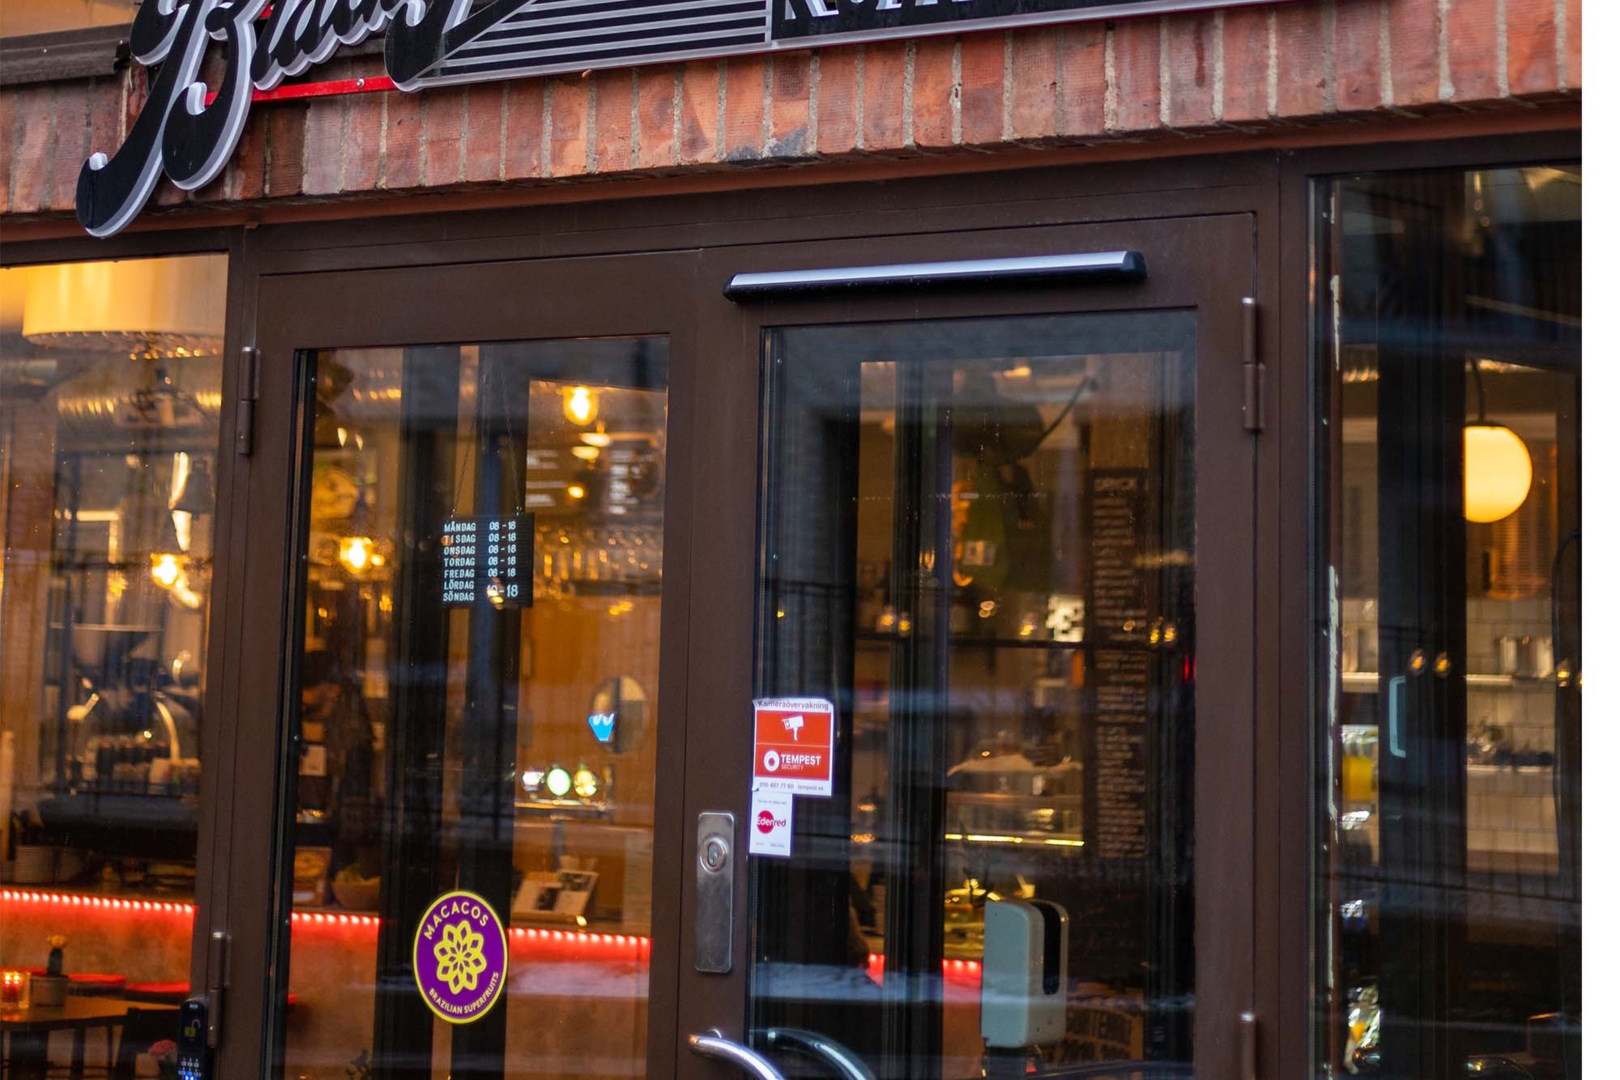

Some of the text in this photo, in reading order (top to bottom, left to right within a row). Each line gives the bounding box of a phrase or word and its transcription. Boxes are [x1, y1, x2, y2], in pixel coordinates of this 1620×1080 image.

[443, 521, 476, 532] MÅNDAG
[444, 534, 476, 544] TISDAG
[443, 546, 476, 555] ONSDAG
[444, 557, 476, 567] TORDAG
[444, 569, 475, 579] FREDAG
[444, 579, 475, 590] LÖRDAG
[443, 591, 475, 602] SÖNDAG
[758, 700, 829, 711] Kameraövervakning
[781, 753, 822, 766] TEMPEST
[757, 816, 787, 827] Edenred
[424, 901, 489, 940] MACACOS
[429, 971, 499, 1014] BRAZILIAN SUPERFRUITS
